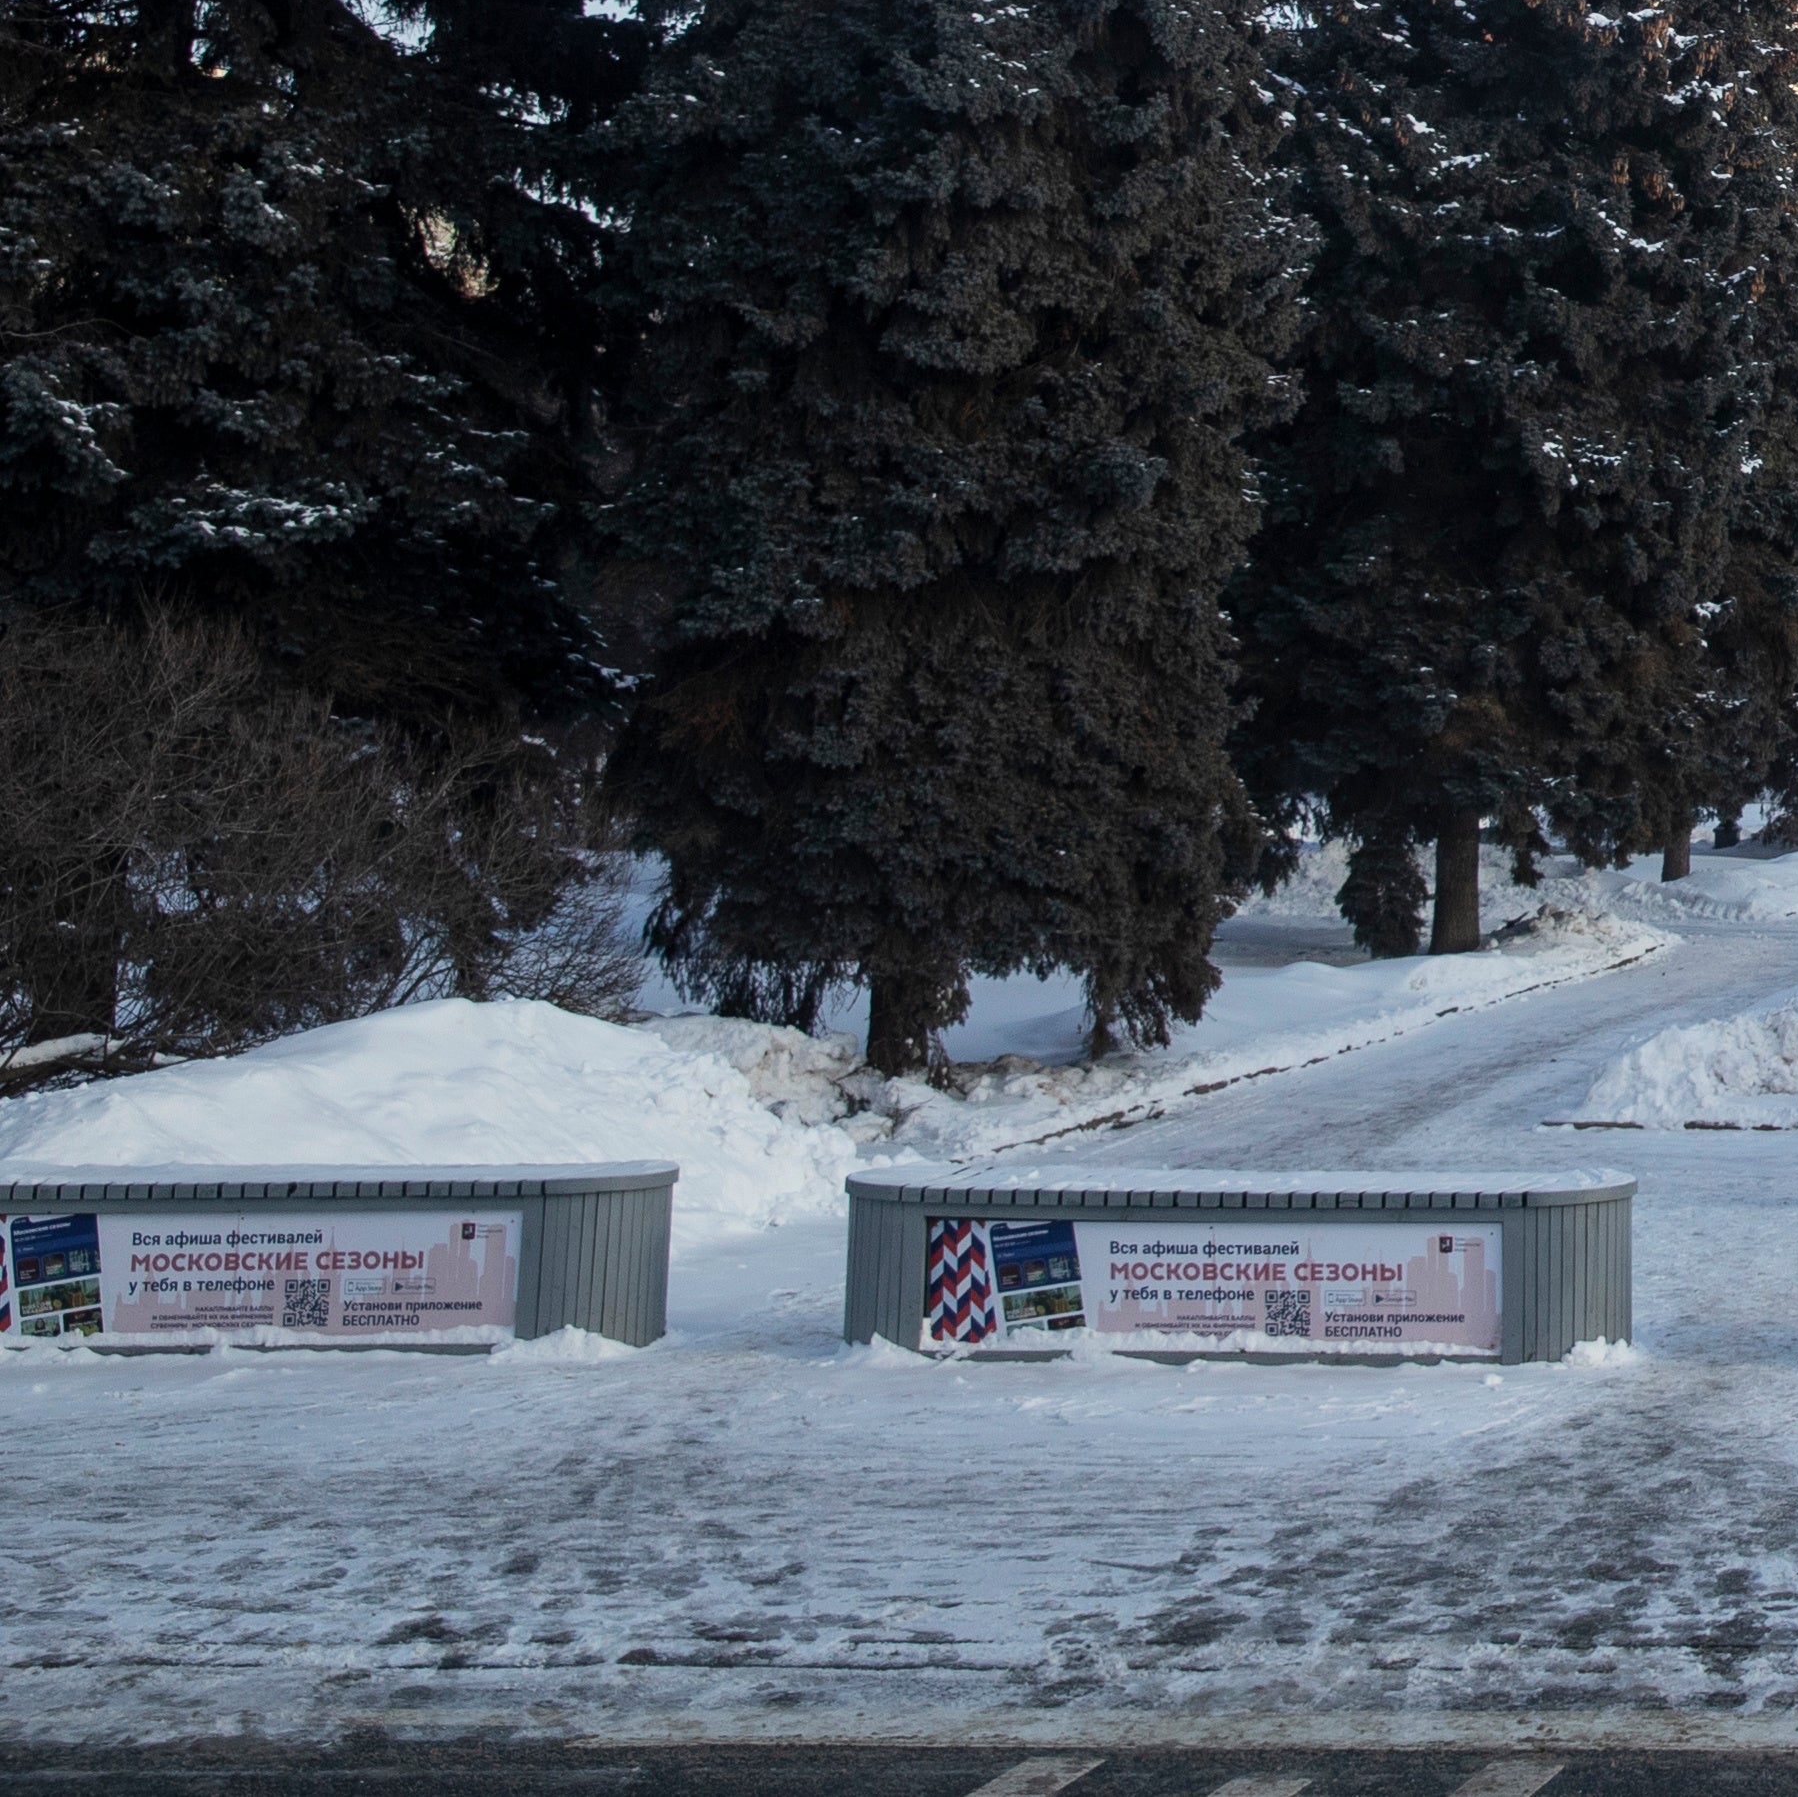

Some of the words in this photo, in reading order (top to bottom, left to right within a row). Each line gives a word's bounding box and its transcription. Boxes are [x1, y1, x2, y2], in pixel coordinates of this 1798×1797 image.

[133, 1232, 160, 1246] Вся
[165, 1232, 222, 1249] афиша
[226, 1230, 323, 1249] фестивалей
[1110, 1241, 1138, 1255] Вся
[1142, 1241, 1198, 1257] афиша
[1203, 1239, 1300, 1257] фестивалей
[131, 1252, 307, 1272] МОСКОВСКИЕ
[316, 1250, 424, 1271] СЕЗОНЫ
[1110, 1262, 1286, 1281] МОСКОВСКИЕ
[1294, 1262, 1403, 1282] СЕЗОНЫ
[128, 1282, 138, 1296] у
[142, 1277, 177, 1292] тебя
[183, 1281, 192, 1291] в
[197, 1277, 275, 1295] телефоне
[1110, 1290, 1119, 1303] у
[1123, 1286, 1158, 1300] тебя
[1163, 1290, 1172, 1300] в
[1178, 1286, 1255, 1303] телефоне
[344, 1300, 403, 1312] Установи
[406, 1300, 483, 1313] приложение
[343, 1314, 420, 1326] БЕСПЛАТНО
[1324, 1312, 1384, 1323] Установи
[1387, 1312, 1465, 1325] приложение
[1325, 1326, 1403, 1338] БЕСПЛАТНО
